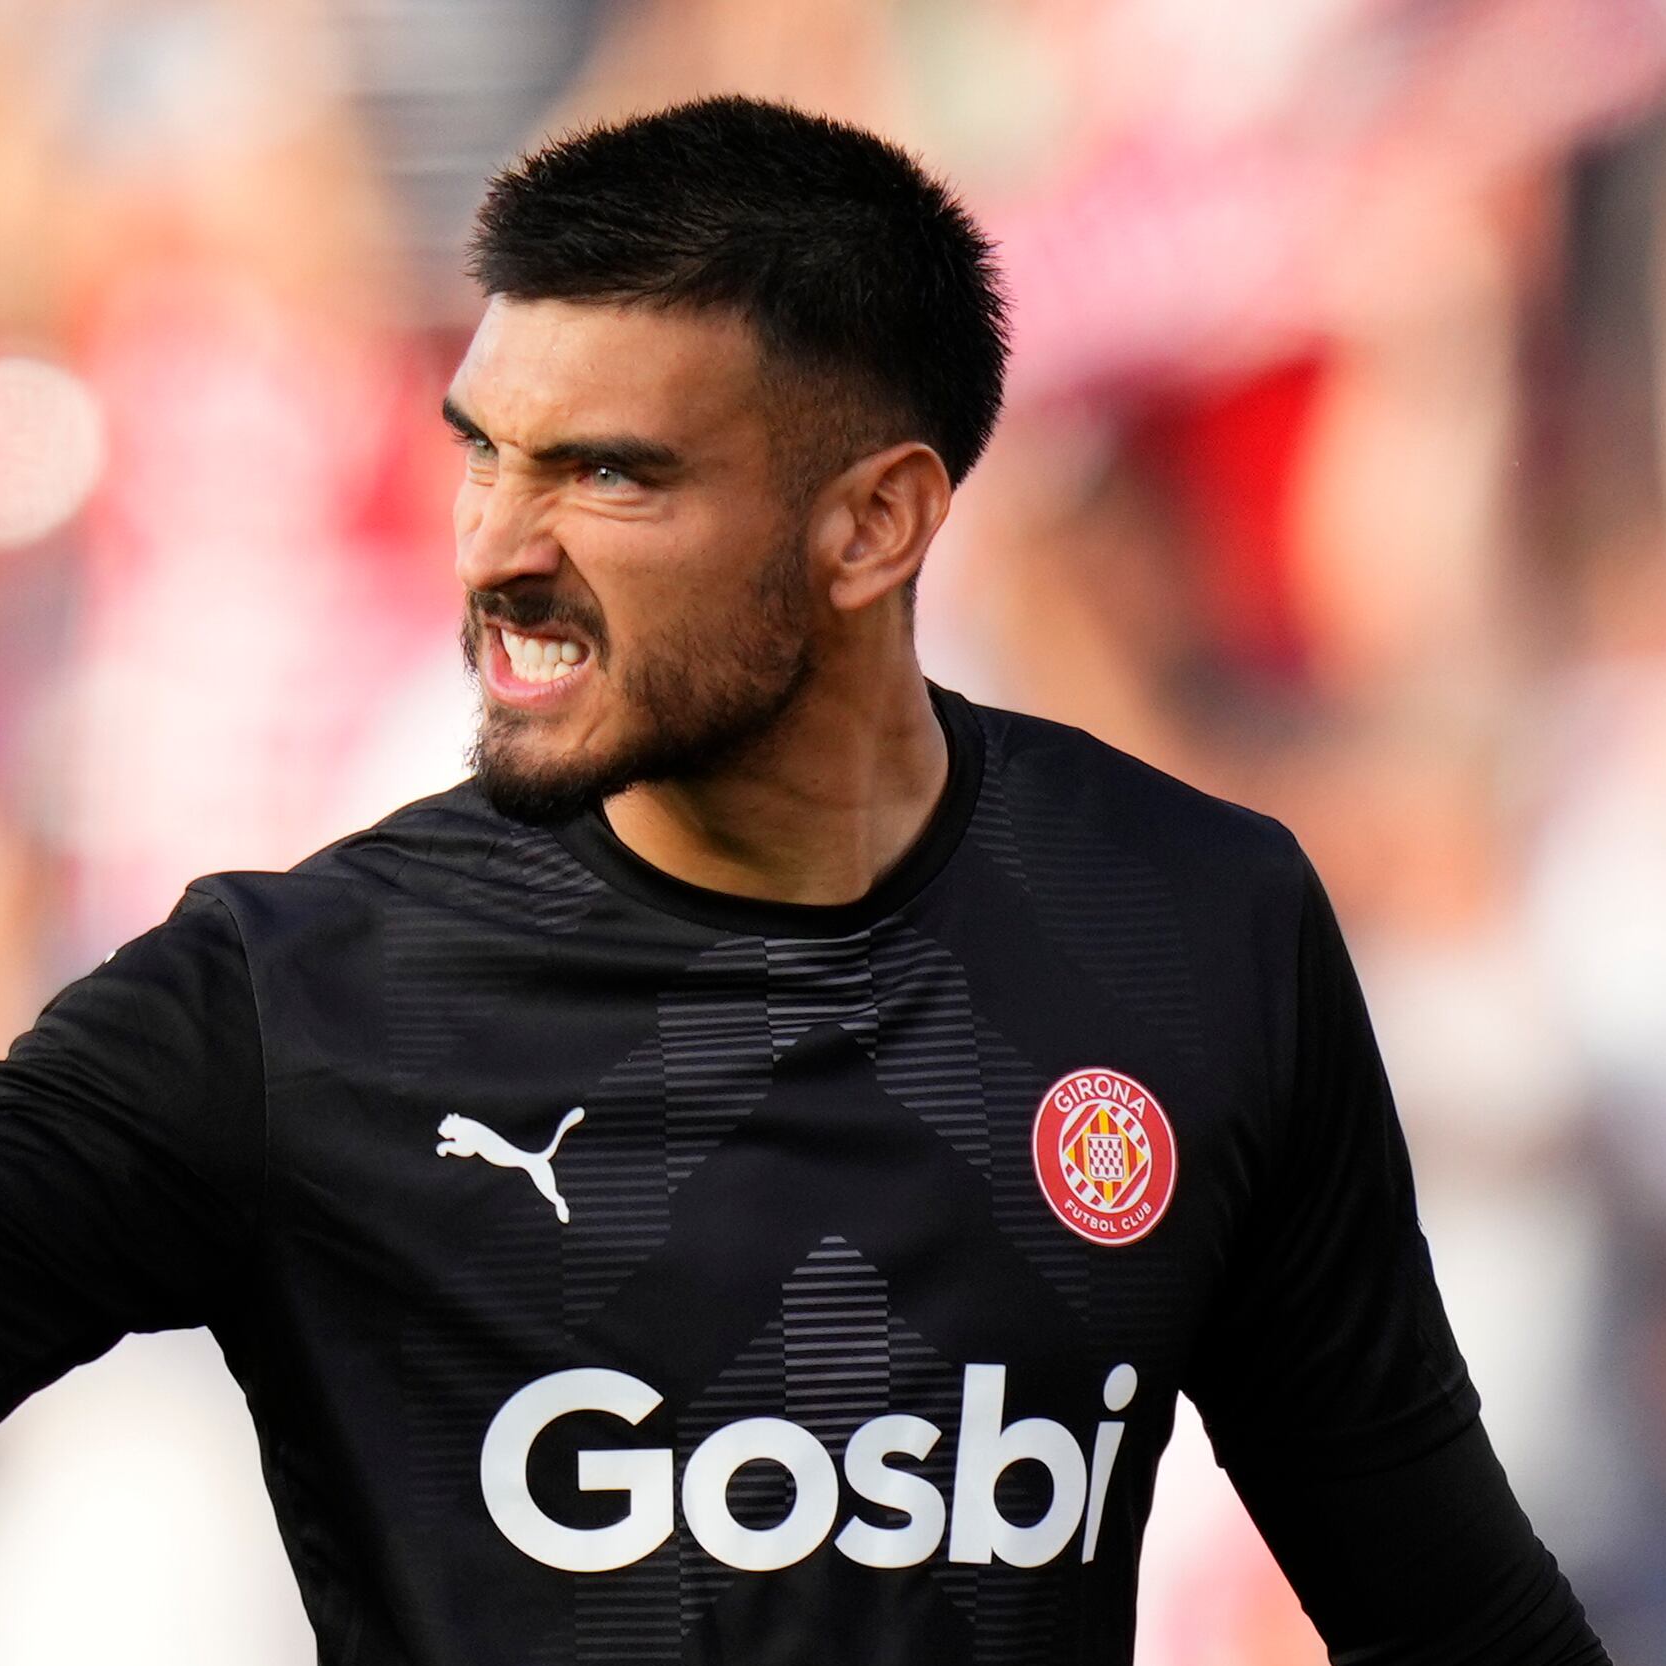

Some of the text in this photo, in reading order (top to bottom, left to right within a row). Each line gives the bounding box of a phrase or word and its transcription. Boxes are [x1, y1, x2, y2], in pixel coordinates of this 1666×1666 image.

[1053, 1075, 1146, 1119] GIRONA
[1064, 1199, 1152, 1232] FUTBOL CLUB
[480, 1363, 1138, 1573] Gosbi
